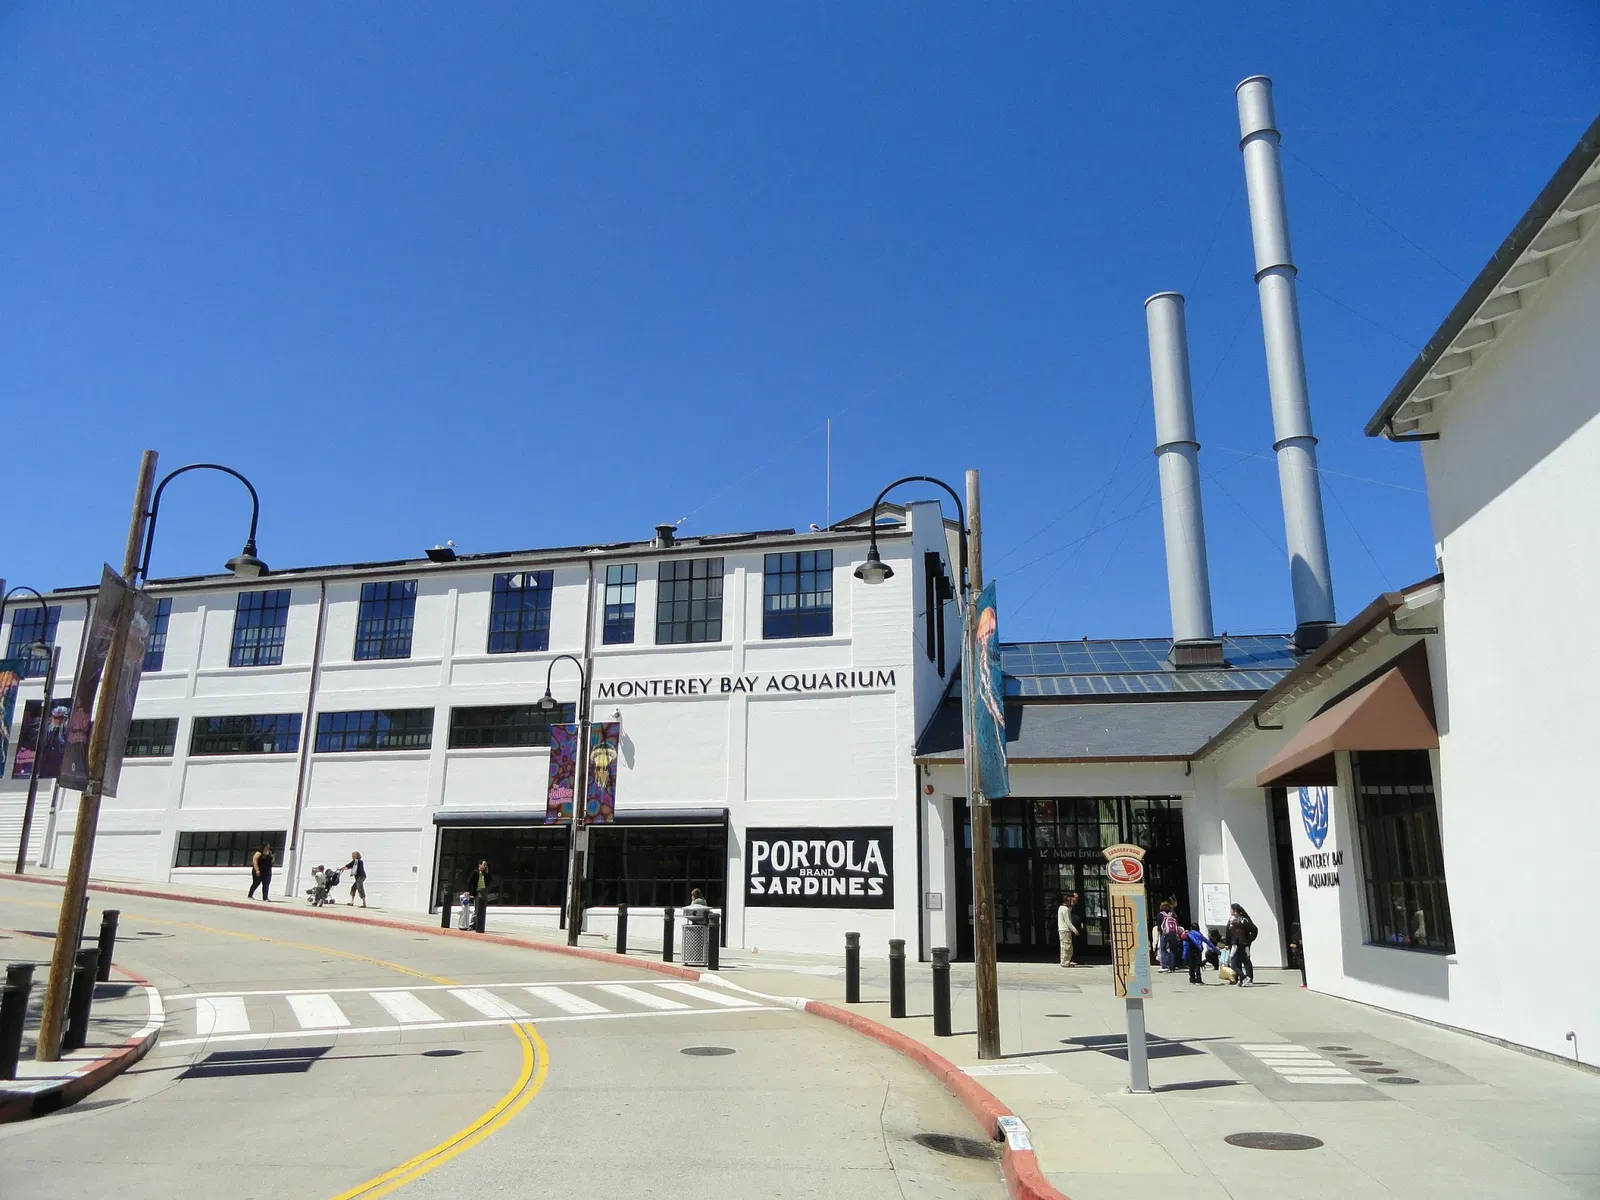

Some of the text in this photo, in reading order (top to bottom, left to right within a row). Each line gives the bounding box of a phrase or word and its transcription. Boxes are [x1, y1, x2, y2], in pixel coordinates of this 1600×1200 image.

[598, 669, 896, 698] MONTEREY BAY AQUARIUM
[750, 840, 888, 876] PORTOLA
[1053, 849, 1075, 857] Main
[1299, 850, 1344, 869] MONTEREY BAY
[799, 868, 835, 876] BRAND
[1308, 872, 1341, 889] AQUARIUM
[750, 876, 884, 896] SARDINES
